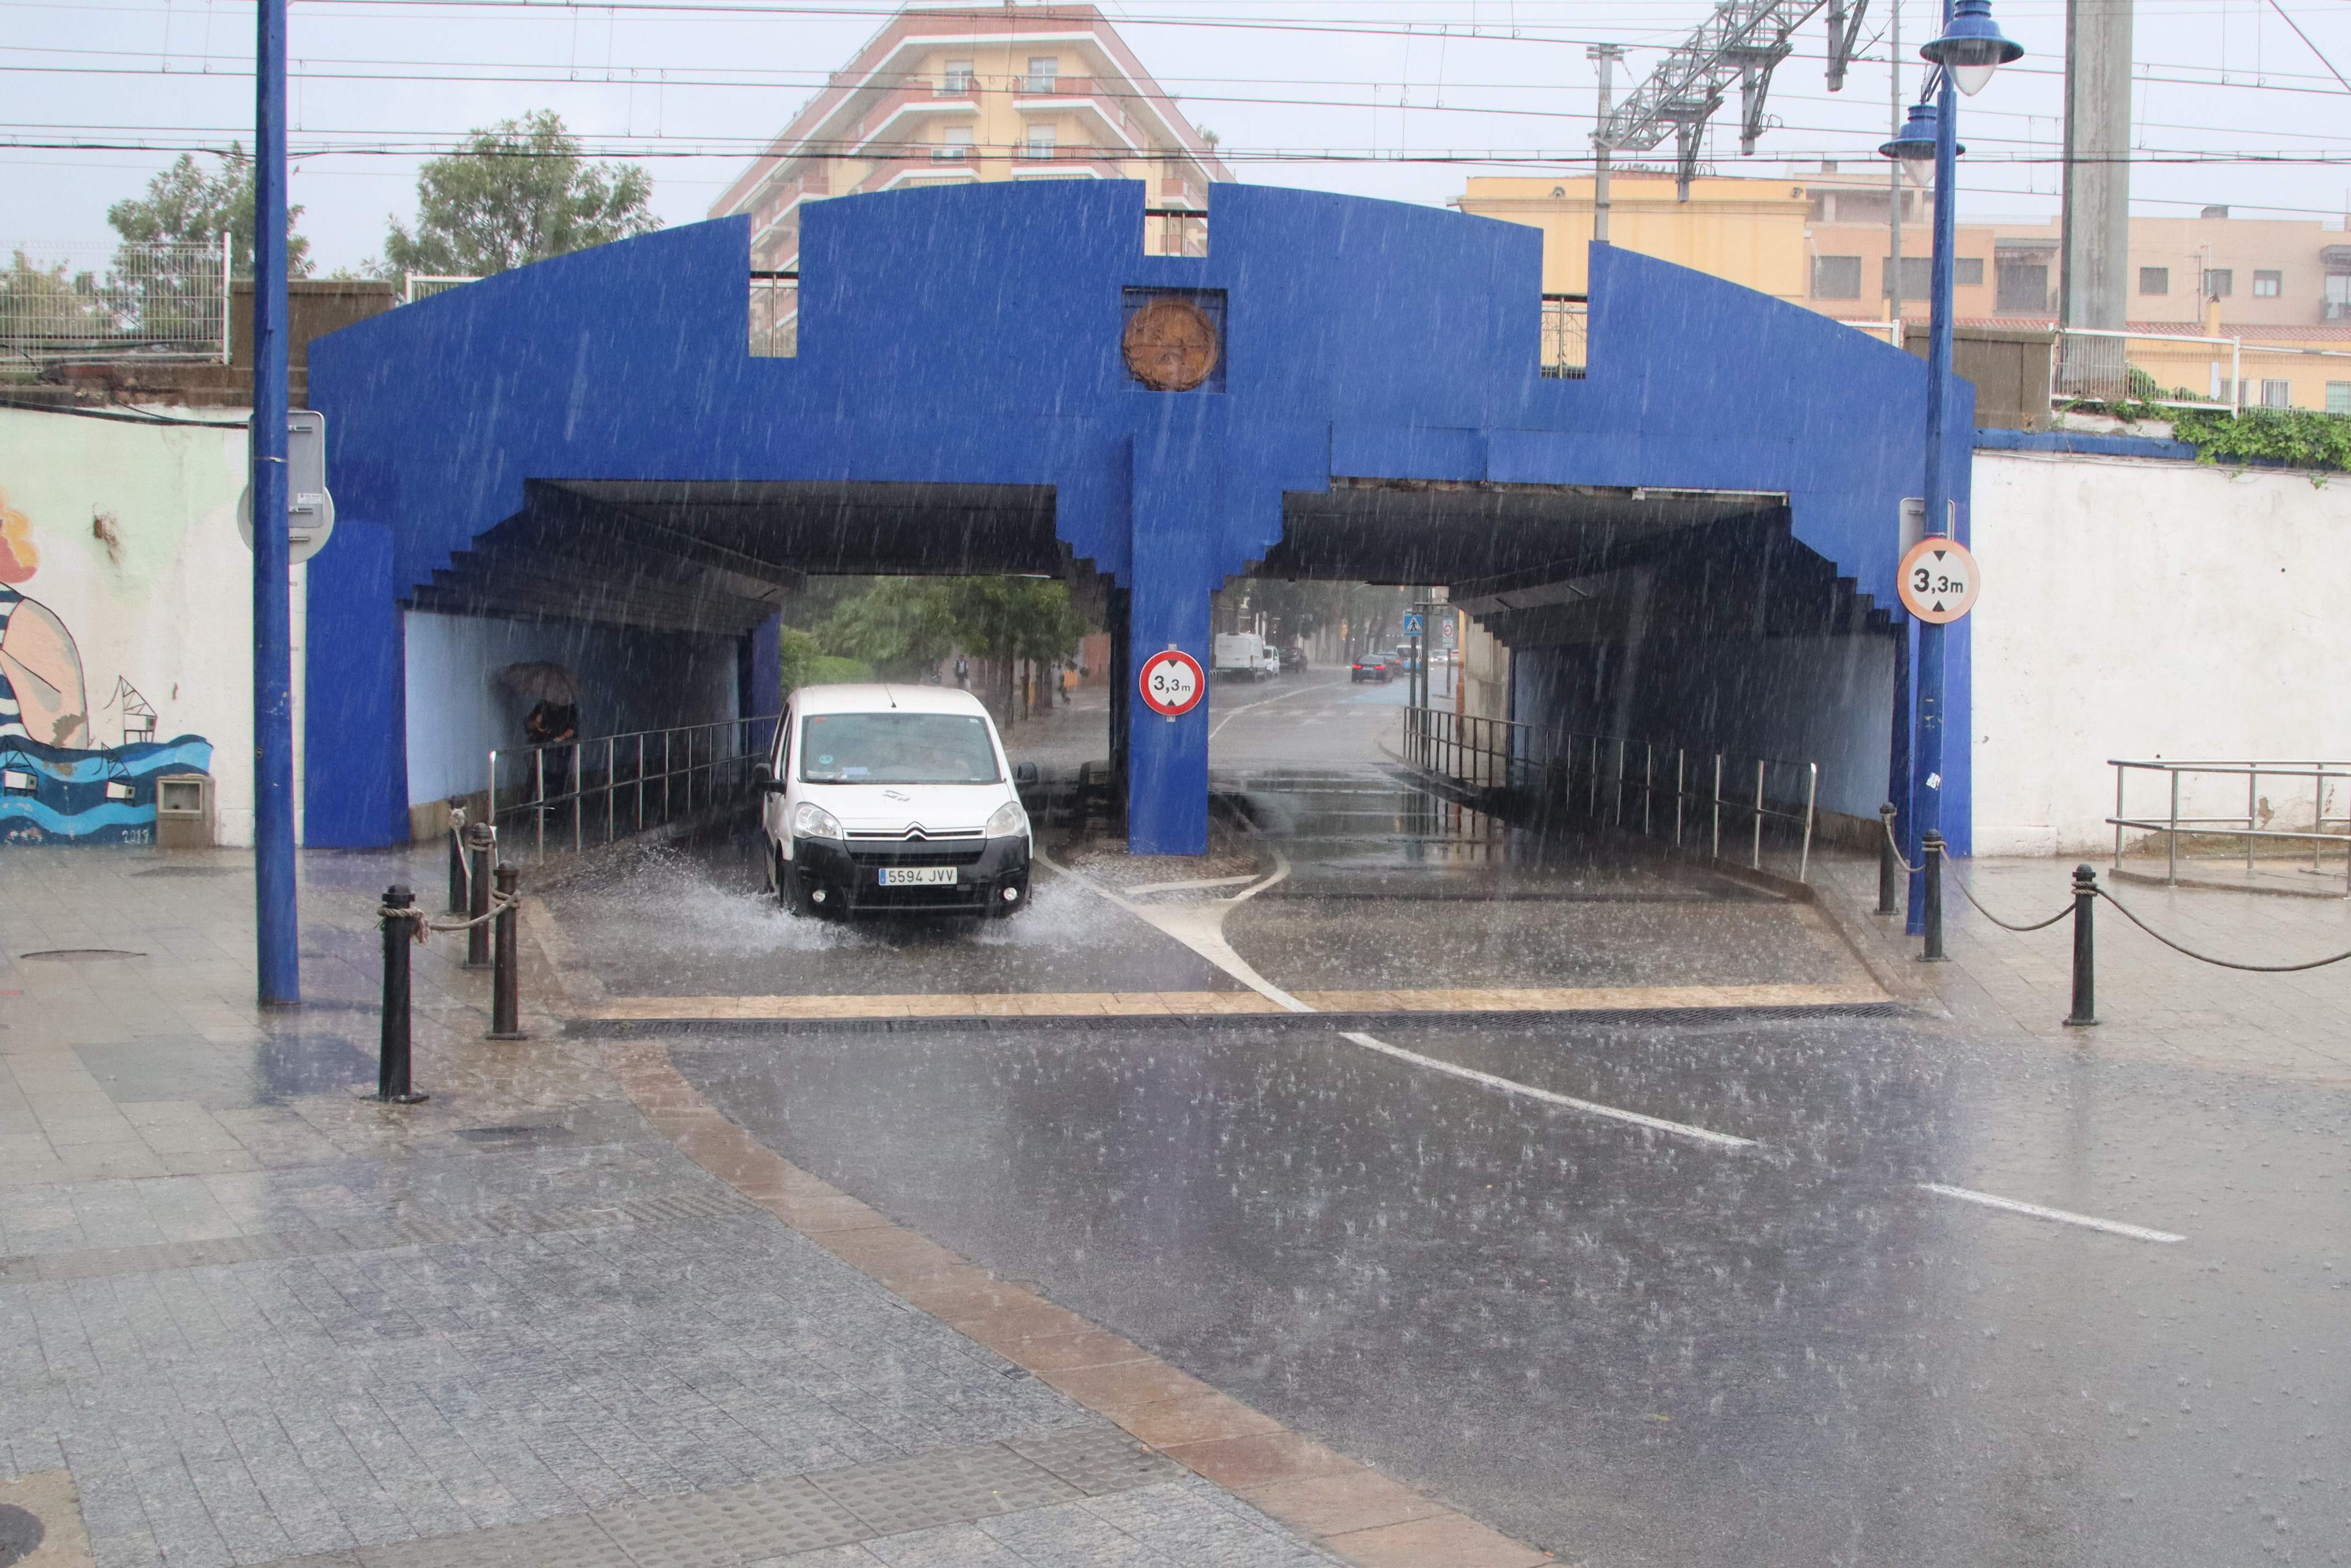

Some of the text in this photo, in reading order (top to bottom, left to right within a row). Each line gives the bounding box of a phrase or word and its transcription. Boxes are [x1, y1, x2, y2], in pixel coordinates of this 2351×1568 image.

[1913, 568, 1963, 594] 3,3m
[888, 869, 953, 883] 5594 JVV
